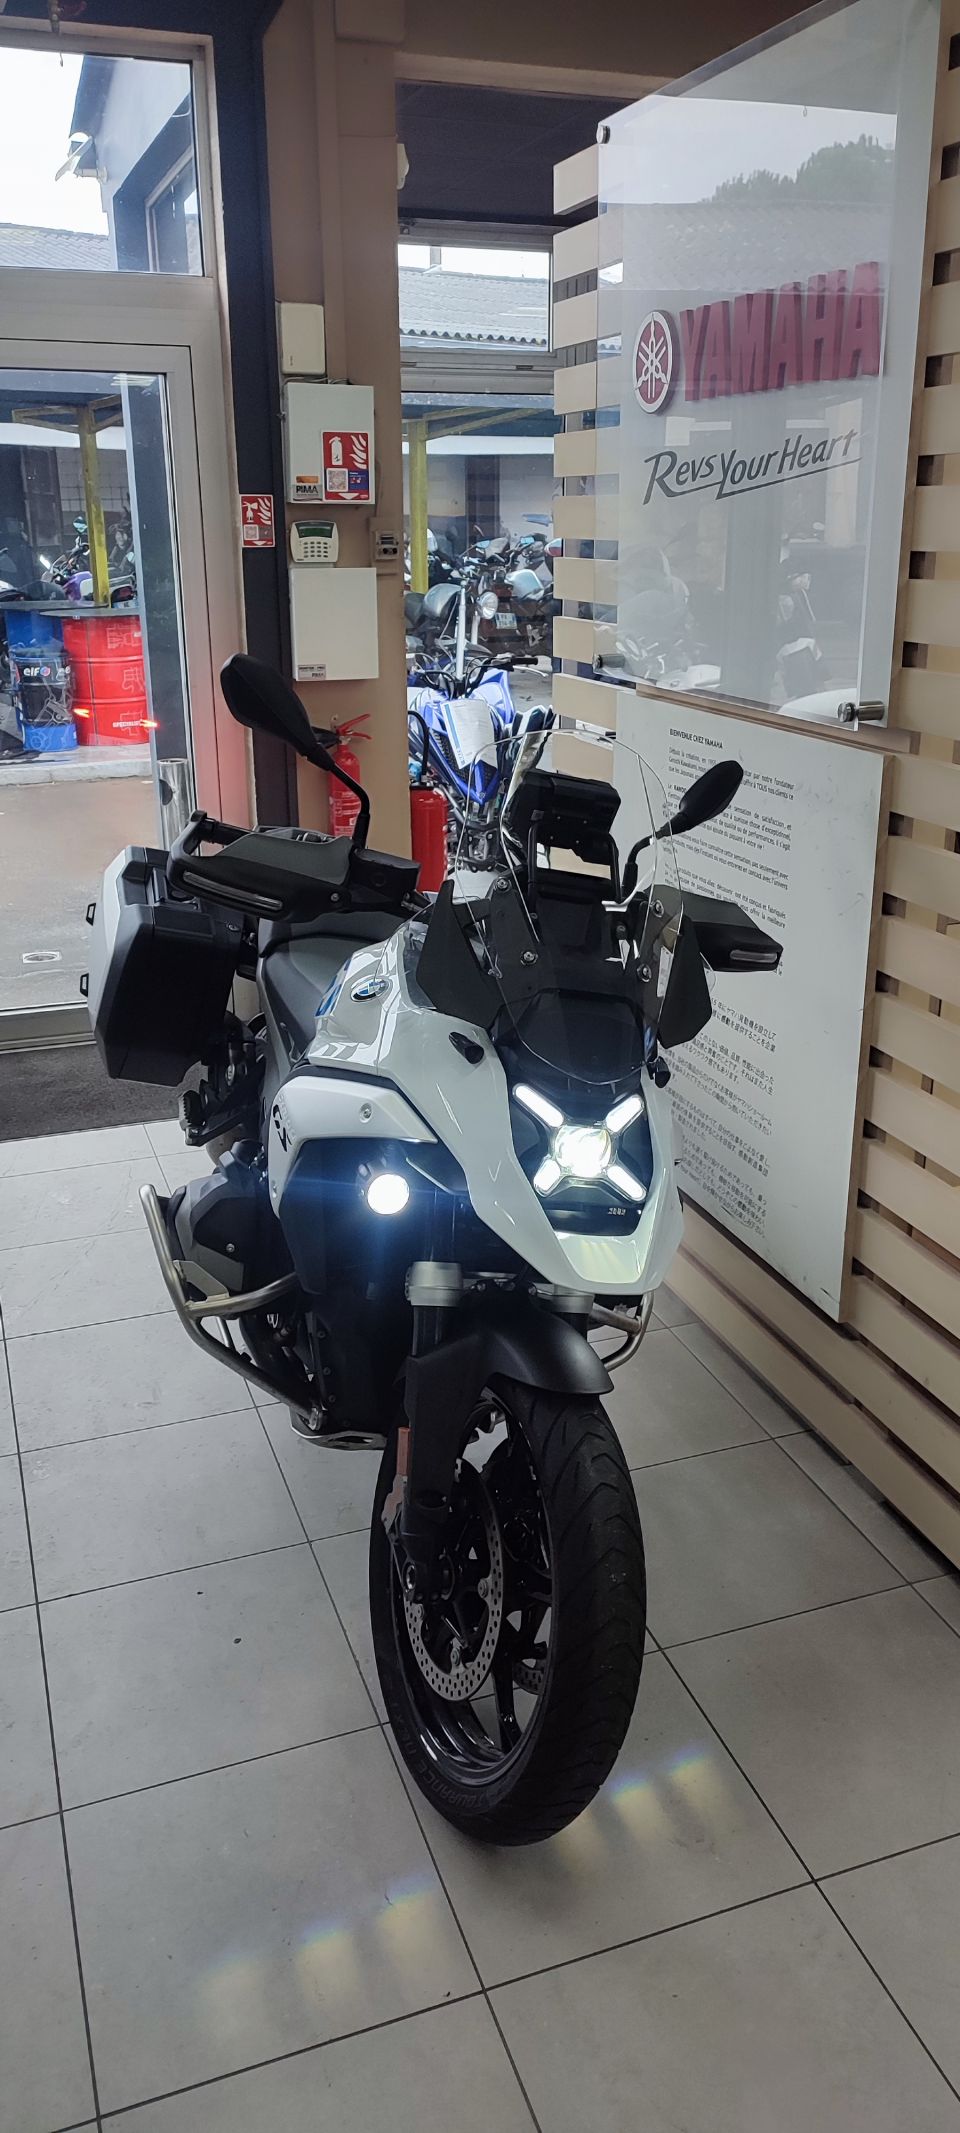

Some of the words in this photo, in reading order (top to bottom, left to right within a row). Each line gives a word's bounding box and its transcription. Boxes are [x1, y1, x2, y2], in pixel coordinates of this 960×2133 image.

[680, 262, 880, 401] YAMAHA
[669, 728, 693, 742] BIENVENUE
[704, 737, 723, 749] YAMAHA
